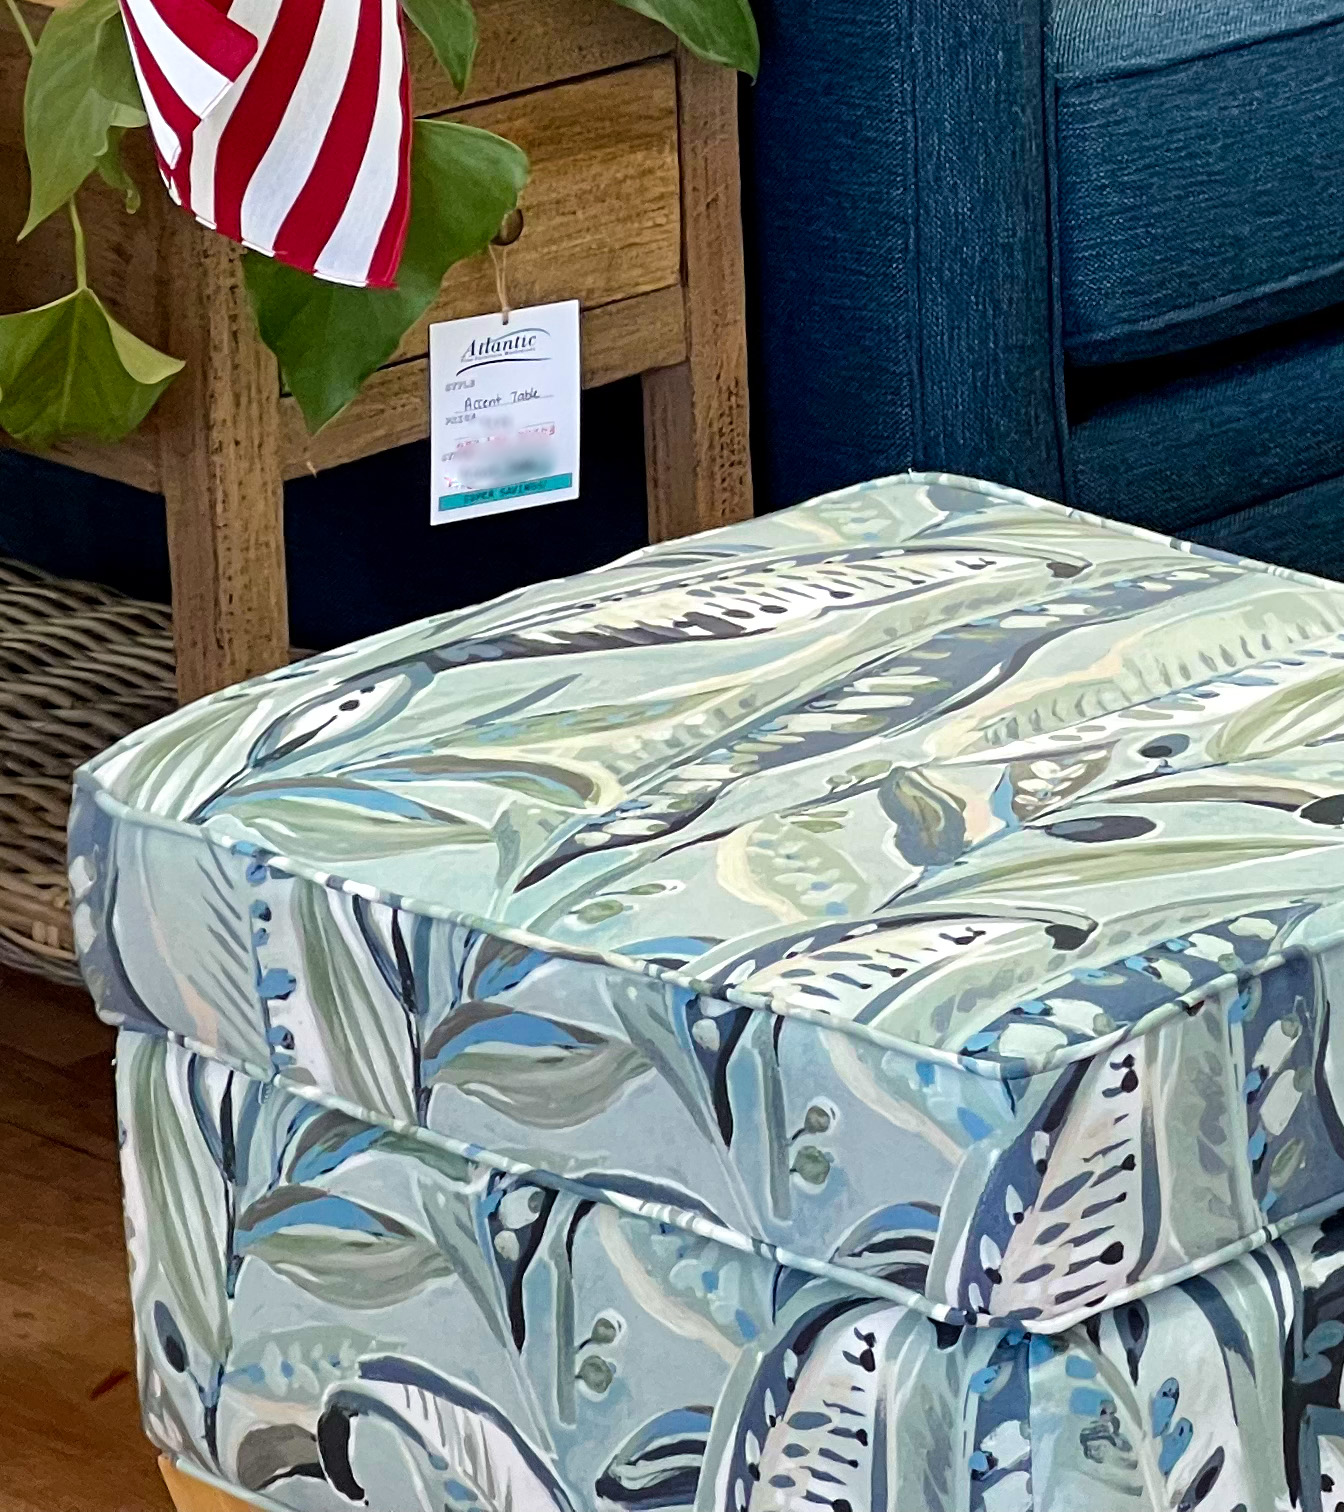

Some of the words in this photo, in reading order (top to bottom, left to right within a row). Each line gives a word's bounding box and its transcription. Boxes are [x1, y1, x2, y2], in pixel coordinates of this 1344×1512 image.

[460, 335, 537, 362] Atlantic
[464, 393, 502, 412] Accent
[510, 387, 541, 404] Table
